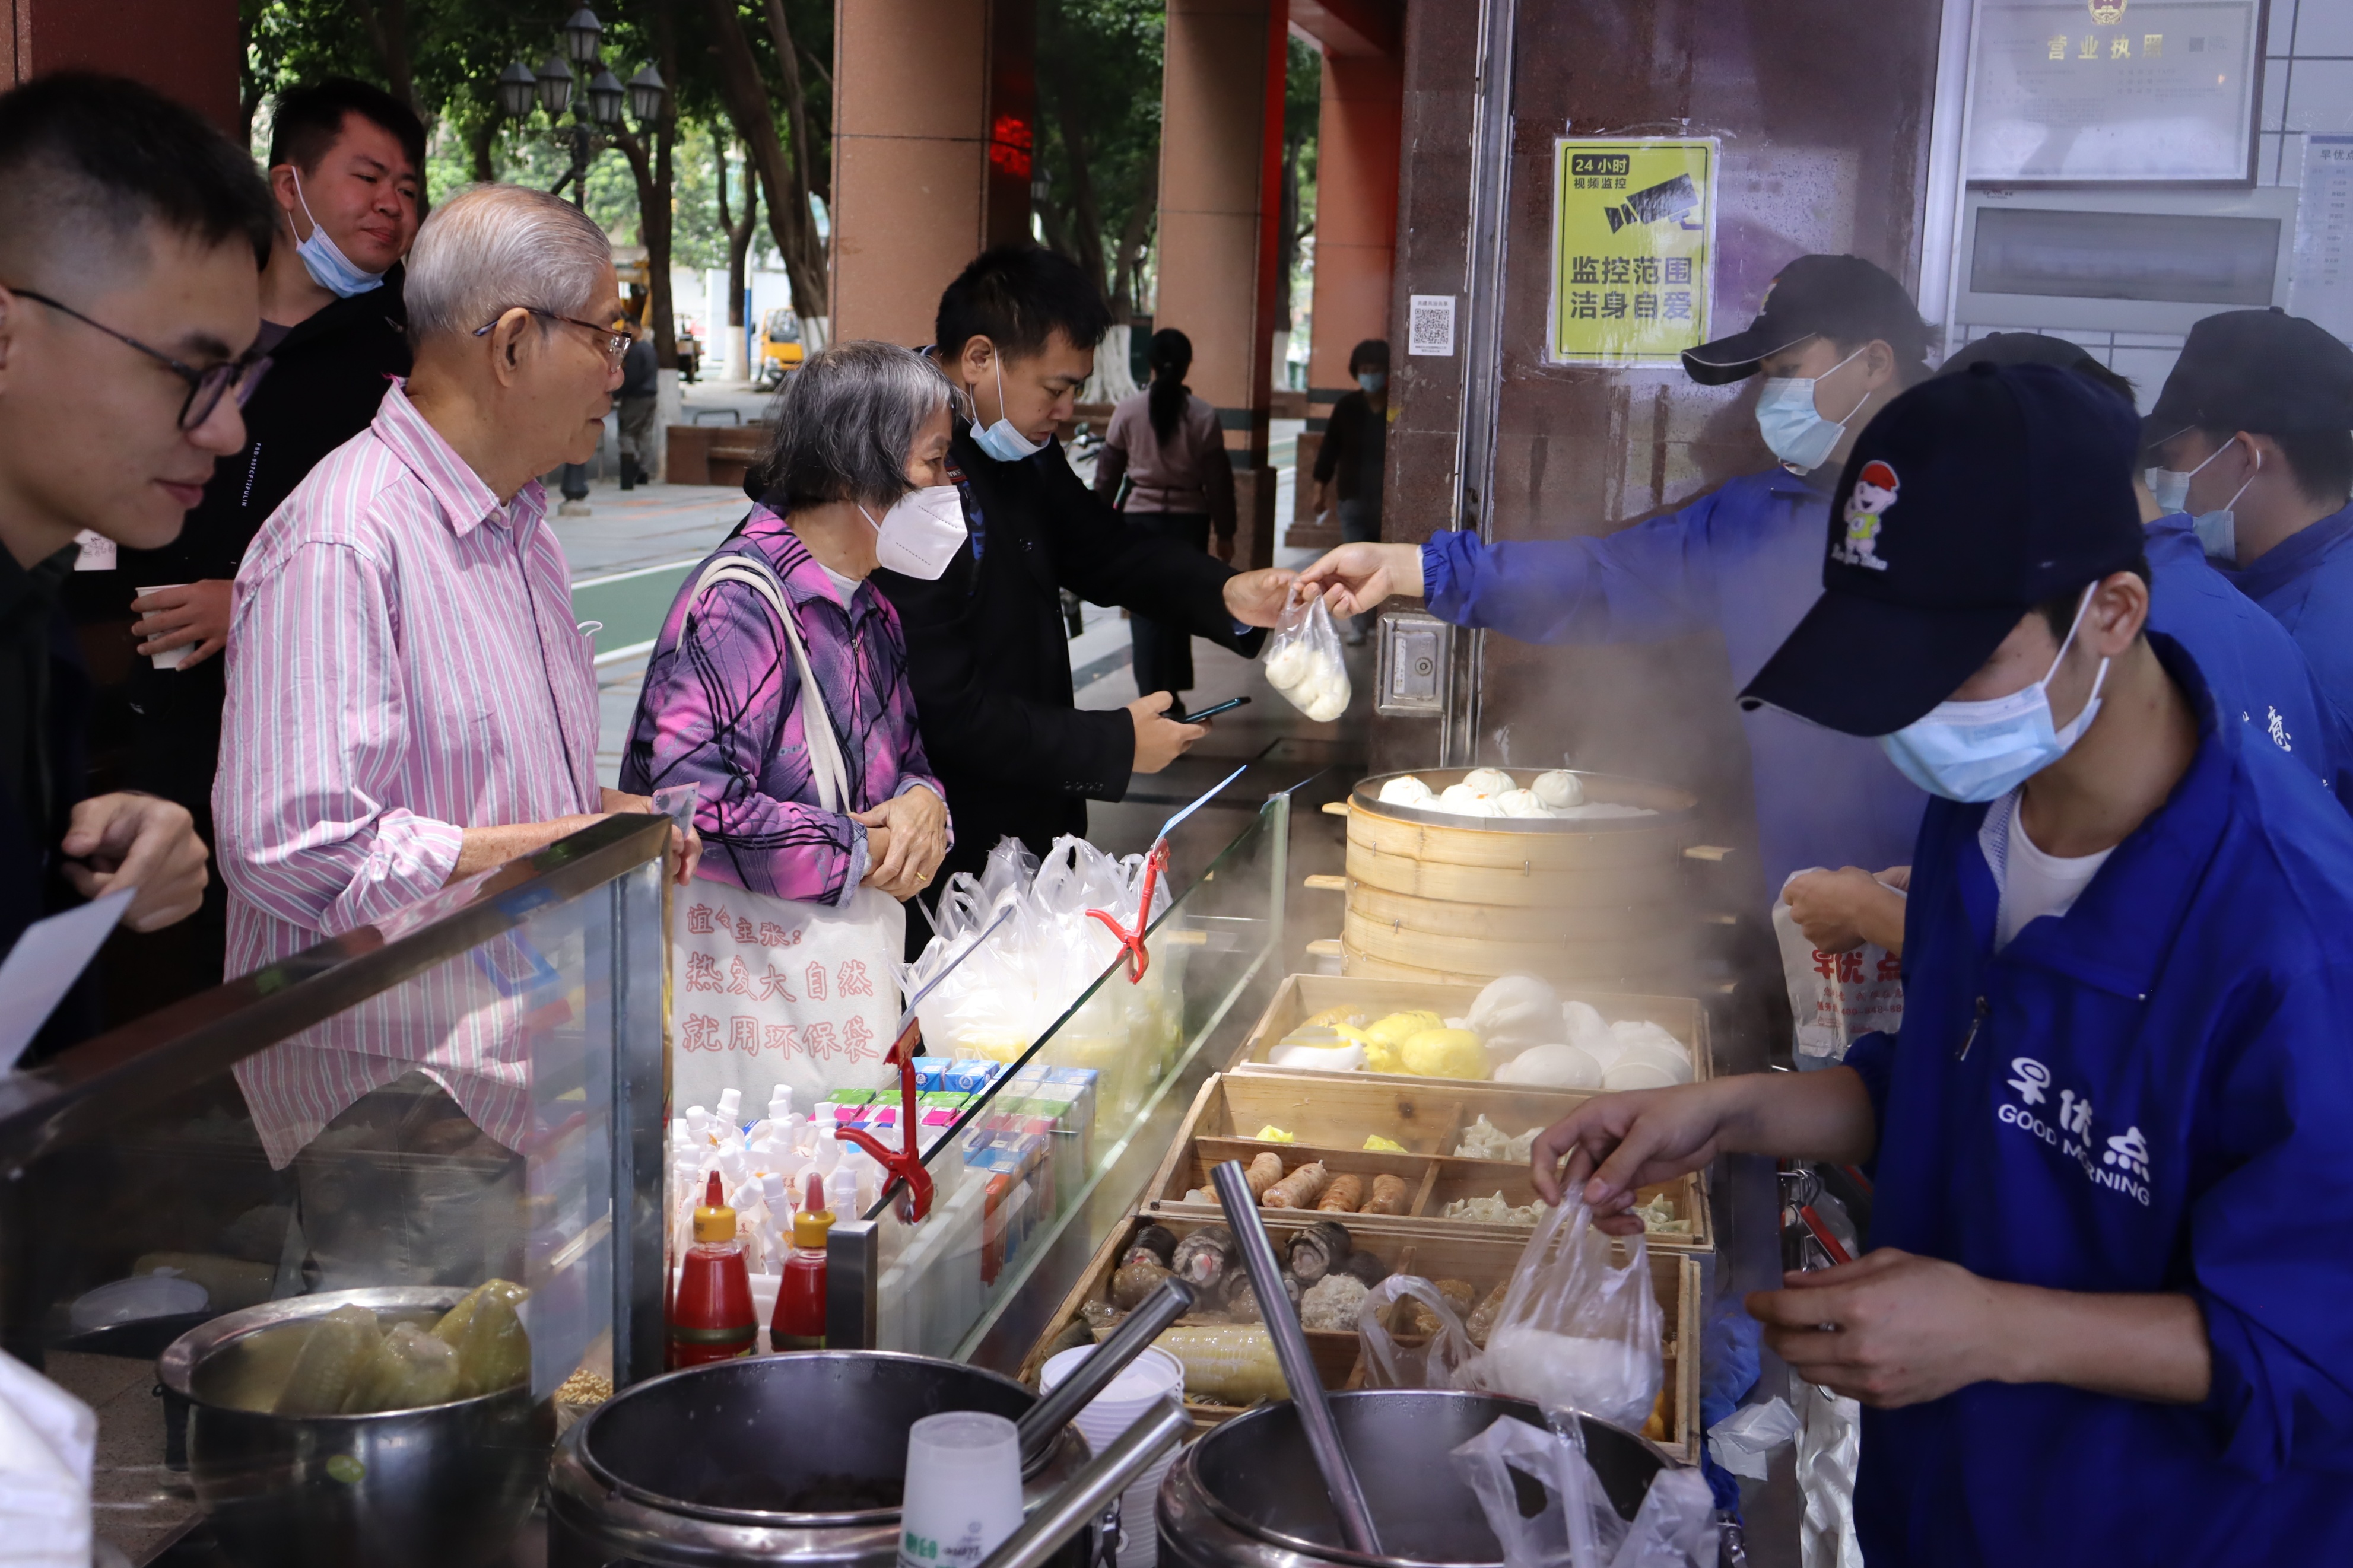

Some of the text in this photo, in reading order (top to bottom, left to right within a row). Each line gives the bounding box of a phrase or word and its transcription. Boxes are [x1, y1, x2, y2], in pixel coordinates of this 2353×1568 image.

[2047, 34, 2163, 60] 营业执照
[1575, 157, 1627, 173] 24 小时
[1573, 177, 1627, 190] 视频监控
[1570, 256, 1692, 285] 监控范围
[1570, 291, 1692, 320] 洁身自爱
[685, 951, 874, 1003] 热爱大自然
[682, 1013, 879, 1064] 就用环保袋
[1998, 1103, 2151, 1207] GOOD MORNING
